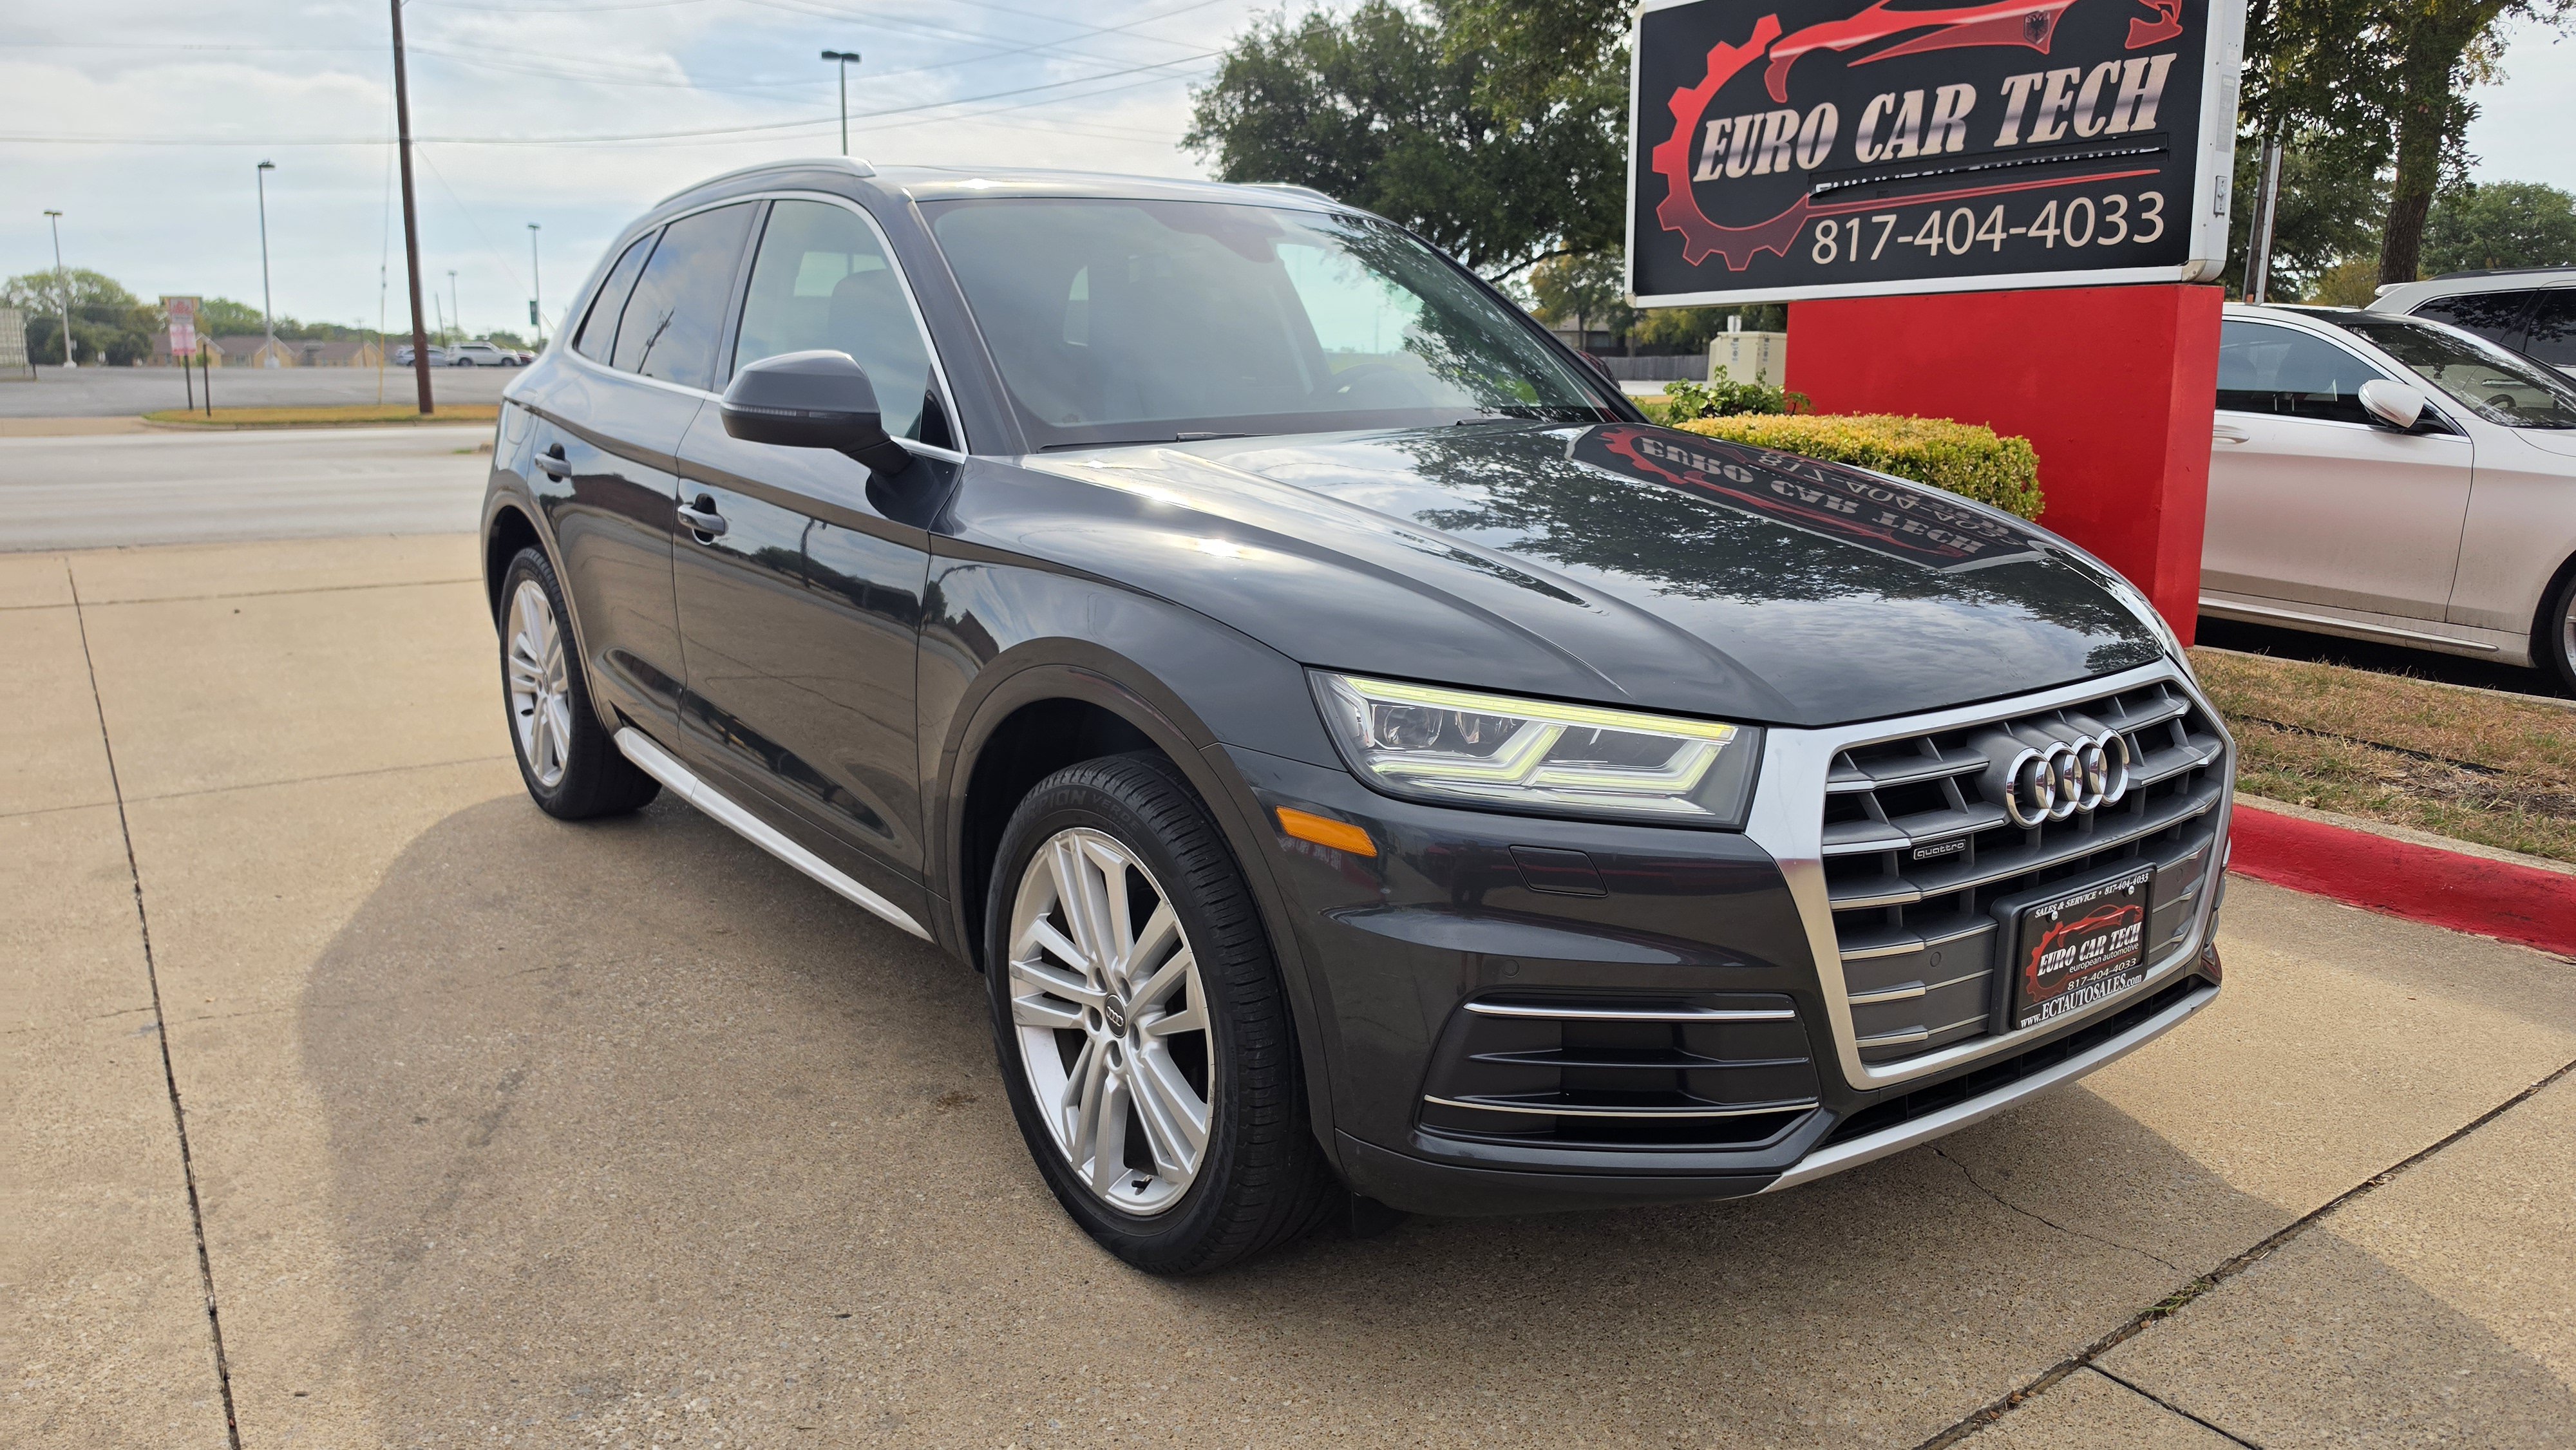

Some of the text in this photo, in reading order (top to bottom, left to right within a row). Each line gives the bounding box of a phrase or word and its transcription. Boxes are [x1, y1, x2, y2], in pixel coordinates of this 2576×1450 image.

[1693, 102, 1839, 182] EURO
[1855, 83, 1976, 162] CAR
[1994, 53, 2177, 147] TECH
[1812, 191, 2164, 265] 817-404-4033
[1917, 842, 1964, 858] quattro
[2035, 872, 2149, 918] SALES & SERVICE 817-404-4033
[2037, 922, 2142, 977] EURO CAR TECH
[2068, 957, 2137, 990] 817-404-4033
[2069, 942, 2139, 974] european automotive
[2020, 973, 2143, 1029] www.ECTAUTOSALES.com
